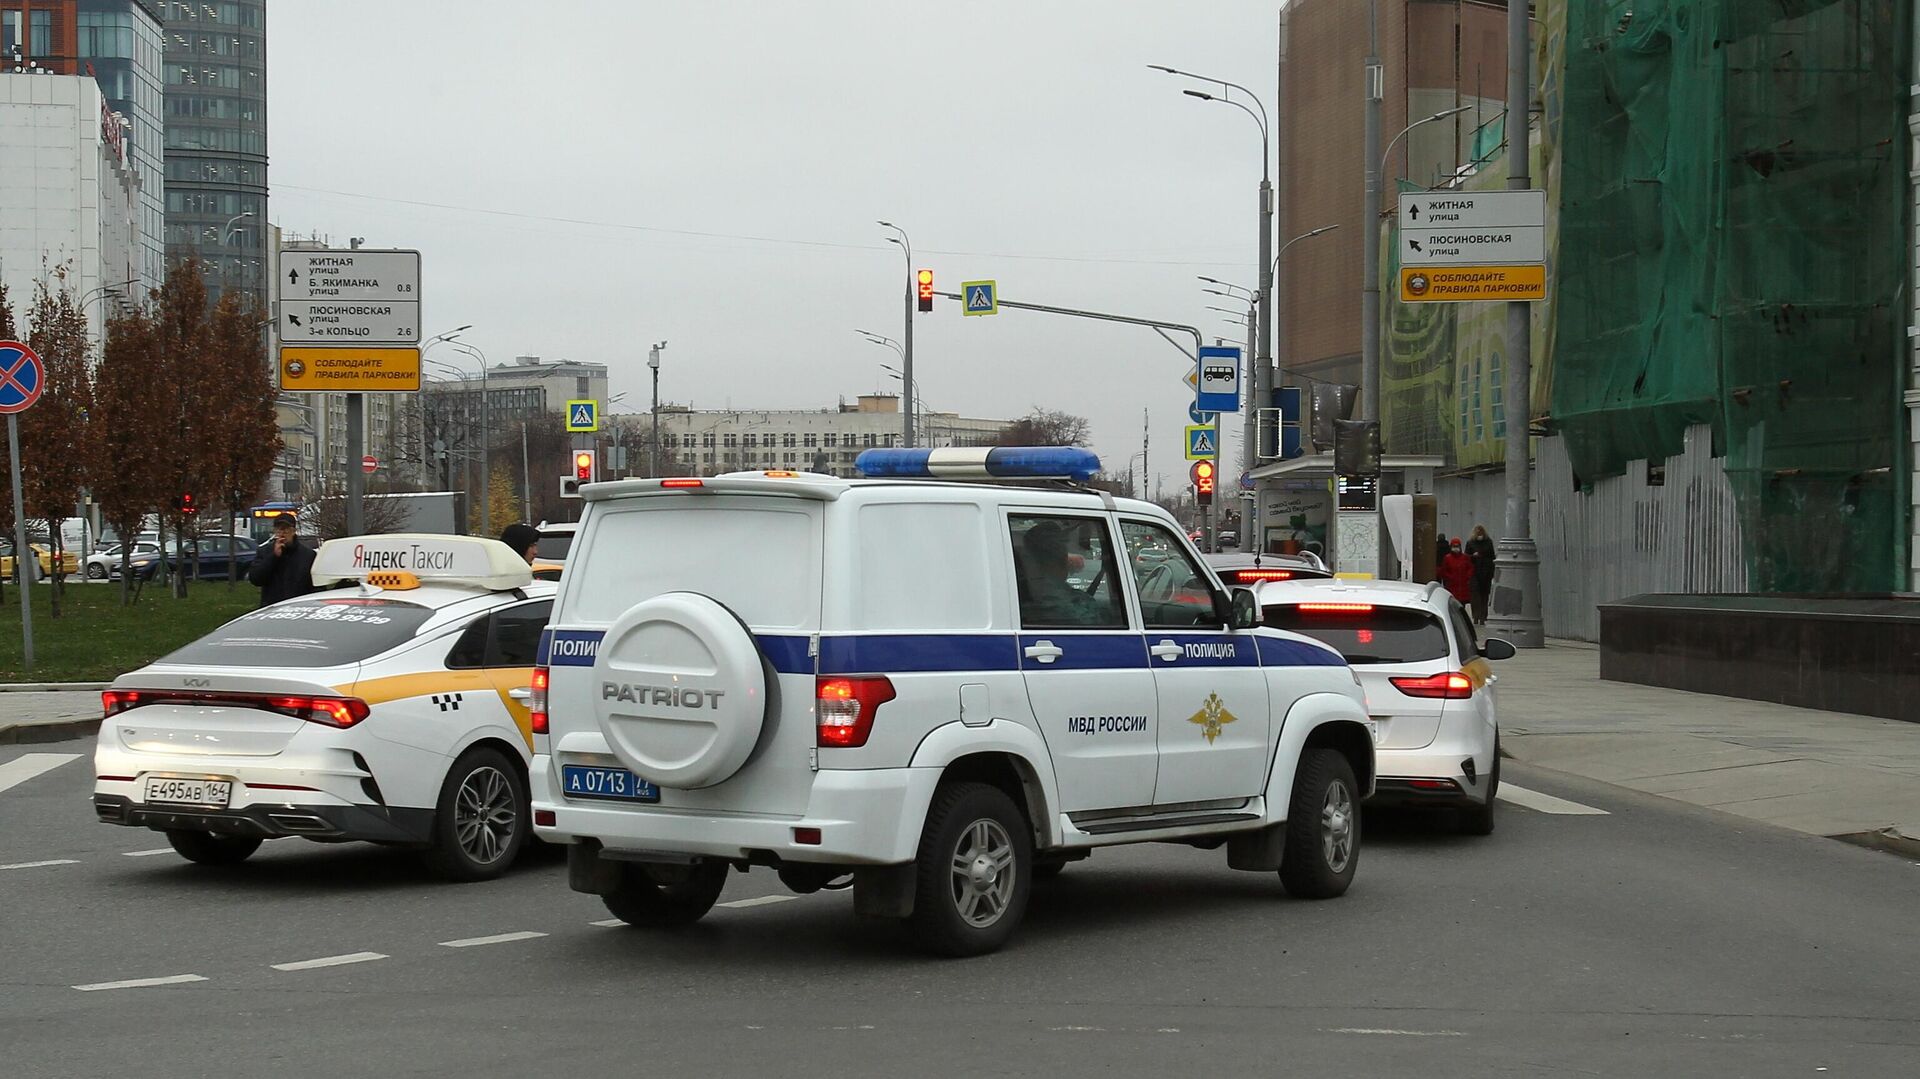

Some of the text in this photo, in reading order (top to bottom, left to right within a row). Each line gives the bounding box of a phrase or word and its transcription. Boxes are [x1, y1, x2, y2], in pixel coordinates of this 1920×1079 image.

[1429, 200, 1474, 209] ЖИТНАЯ
[1429, 214, 1459, 223] улица
[1429, 234, 1512, 245] ЛЮСИНОВСКАЯ
[1429, 248, 1460, 257] улица
[309, 258, 353, 266] ЖИТНАЯ
[309, 267, 339, 276] улица
[309, 278, 379, 287] Б. ЯКИМАНКА
[1432, 272, 1505, 283] СОБЛЮДАЙТЕ
[309, 288, 339, 297] улица
[397, 284, 412, 293] 0.8
[1432, 284, 1541, 294] ПРАВИЛА ПАРКОВКИ!
[309, 306, 391, 315] ЛЮСИНОВСКАЯ
[309, 316, 340, 324] улица
[309, 327, 412, 337] 3-е КОЛЬЦО 2.6
[315, 358, 383, 368] СОБЛЮДАЙТЕ
[314, 371, 416, 379] ПРАВИЛА ПАРКОВКИ!
[352, 544, 454, 571] Яндекс Такси
[305, 612, 339, 621] 999
[338, 614, 363, 623] 99
[363, 616, 392, 625] 99
[1185, 643, 1236, 660] ПОЛИЦИЯ
[602, 680, 726, 710] PATRIOT
[1068, 715, 1147, 735] МВД РОССИИ
[585, 771, 626, 794] 0713
[206, 783, 225, 797] 164
